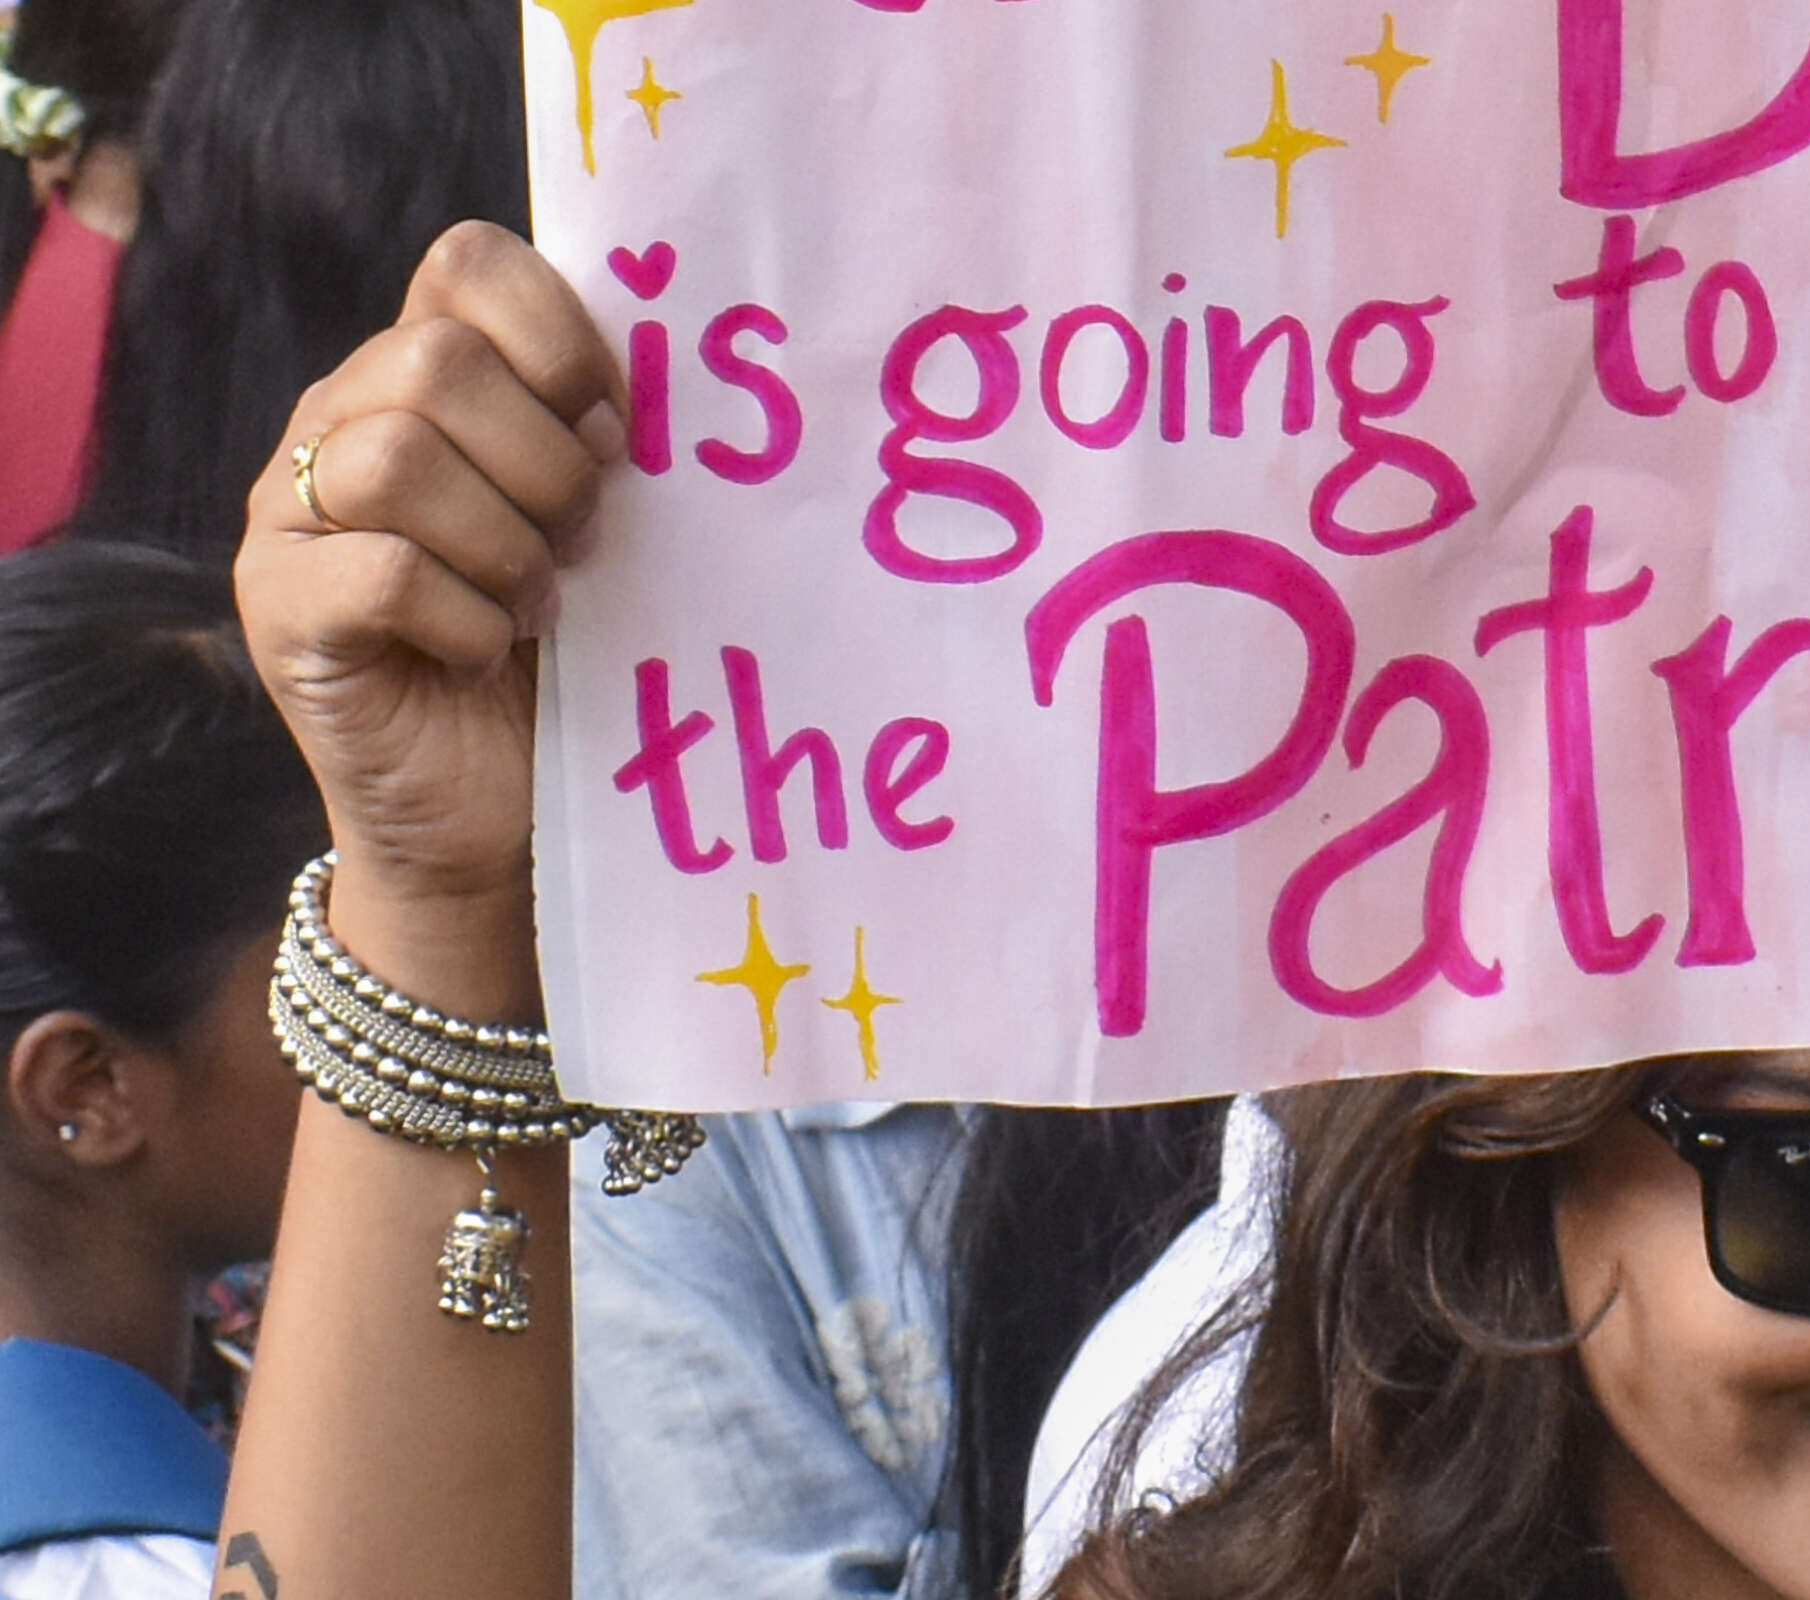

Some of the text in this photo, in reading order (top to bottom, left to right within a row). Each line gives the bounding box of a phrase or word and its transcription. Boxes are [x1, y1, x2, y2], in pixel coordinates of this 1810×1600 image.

[608, 241, 803, 485] is
[863, 272, 1477, 584] going
[1554, 215, 1777, 417] to
[614, 645, 956, 874] the
